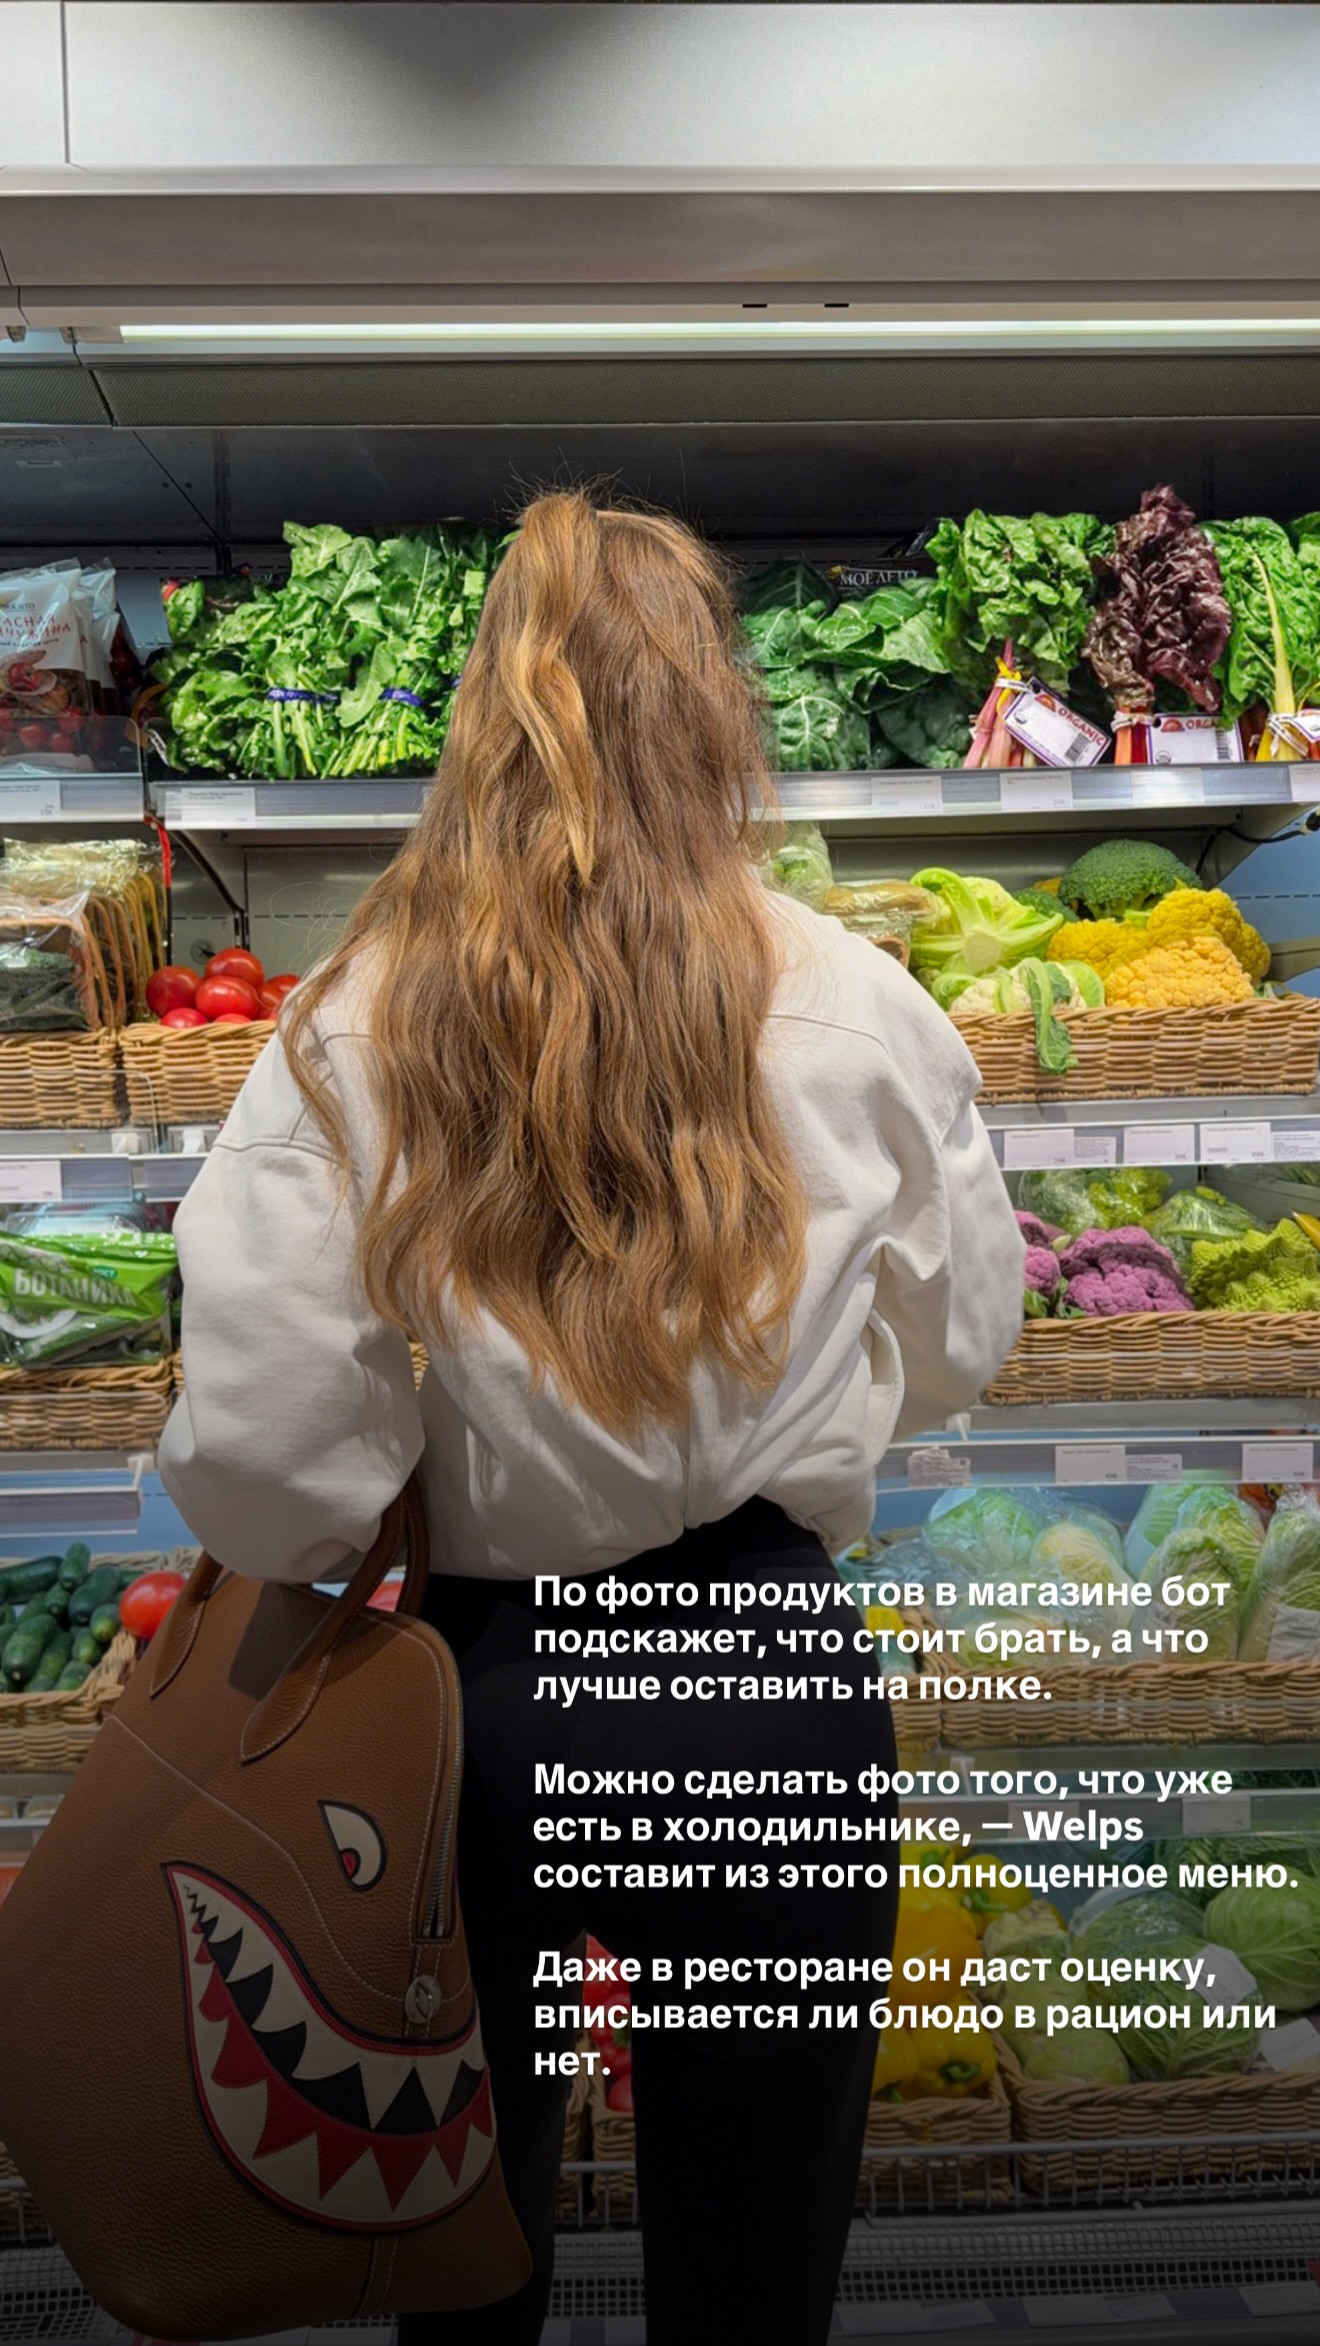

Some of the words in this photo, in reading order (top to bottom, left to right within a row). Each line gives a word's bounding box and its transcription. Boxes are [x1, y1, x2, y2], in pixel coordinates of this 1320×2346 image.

[1058, 707, 1106, 746] ORGANIC
[1186, 719, 1218, 730] ORGA
[15, 1268, 138, 1306] БОТАНИКА
